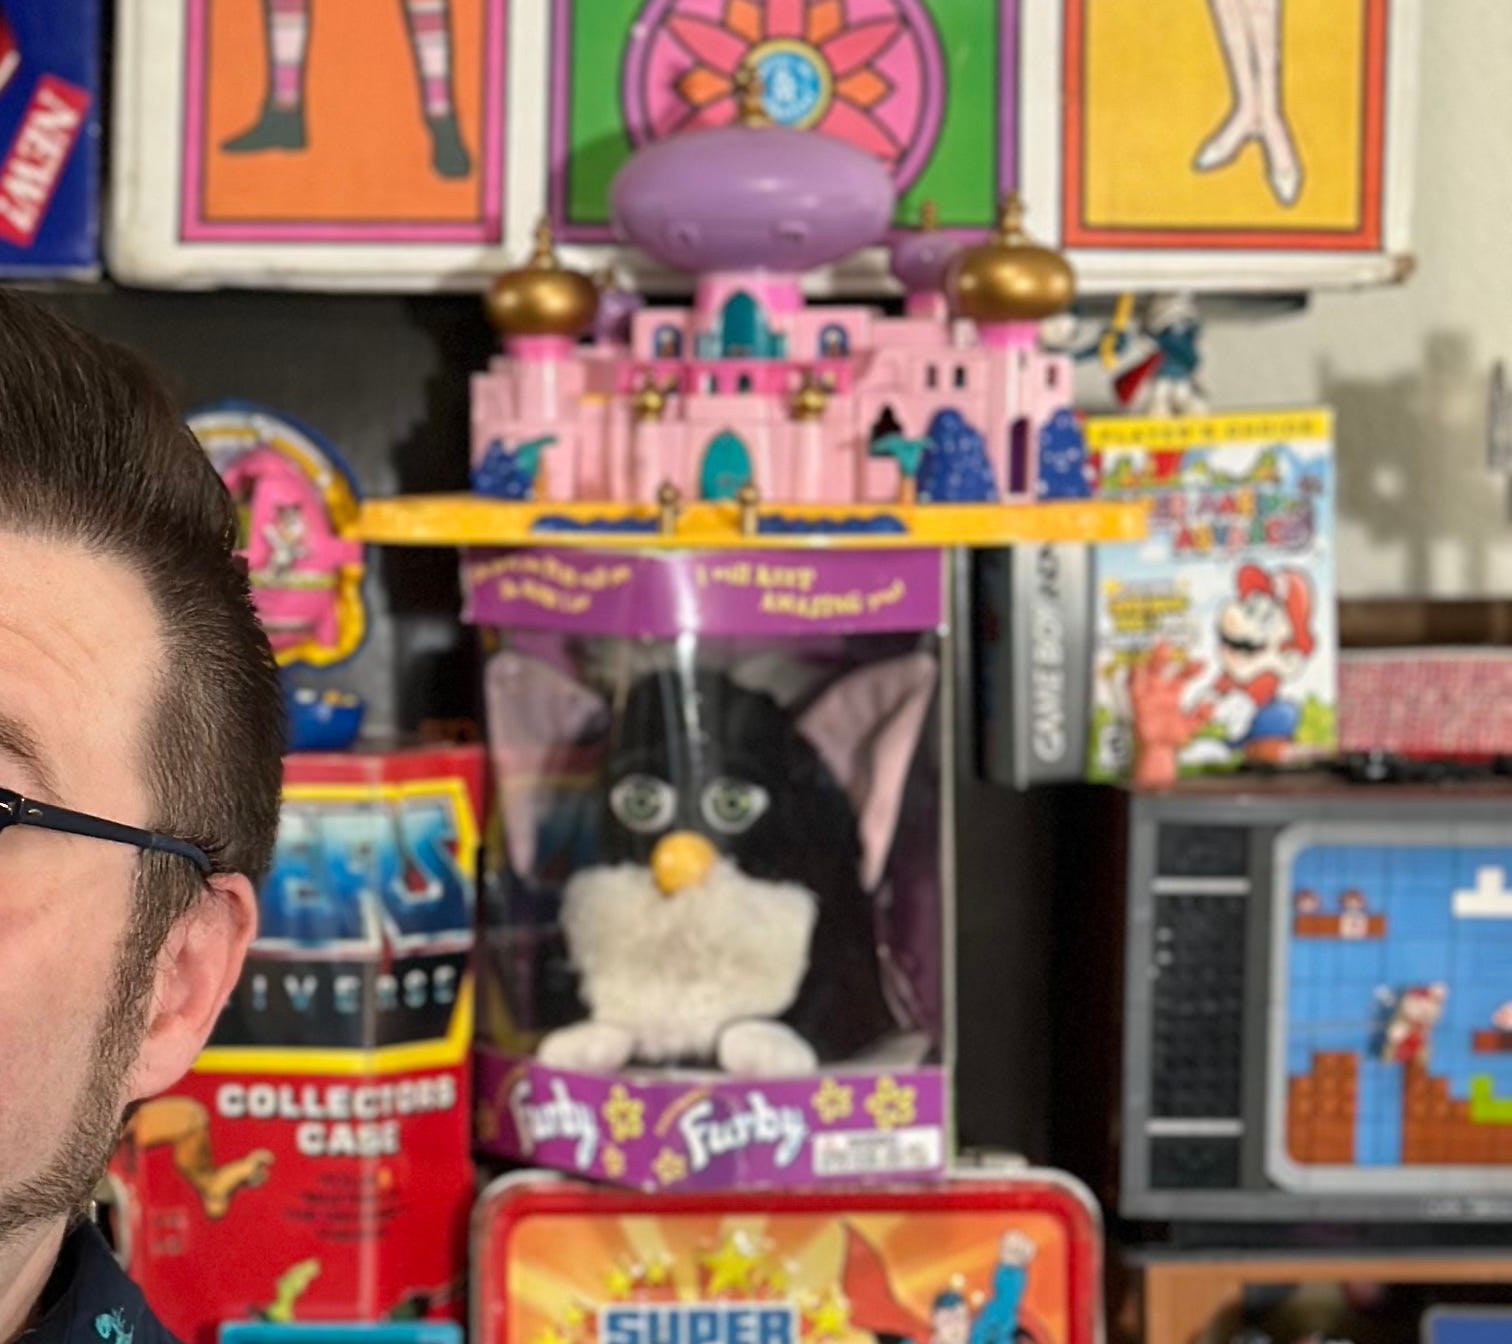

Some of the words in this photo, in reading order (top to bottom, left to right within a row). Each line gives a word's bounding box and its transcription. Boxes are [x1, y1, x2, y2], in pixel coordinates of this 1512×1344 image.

[1032, 668, 1067, 764] GAME
[250, 964, 458, 1014] IVERSE
[215, 1075, 457, 1120] COLLECTORS
[295, 1119, 401, 1157] CASE
[679, 1090, 808, 1172] Furby
